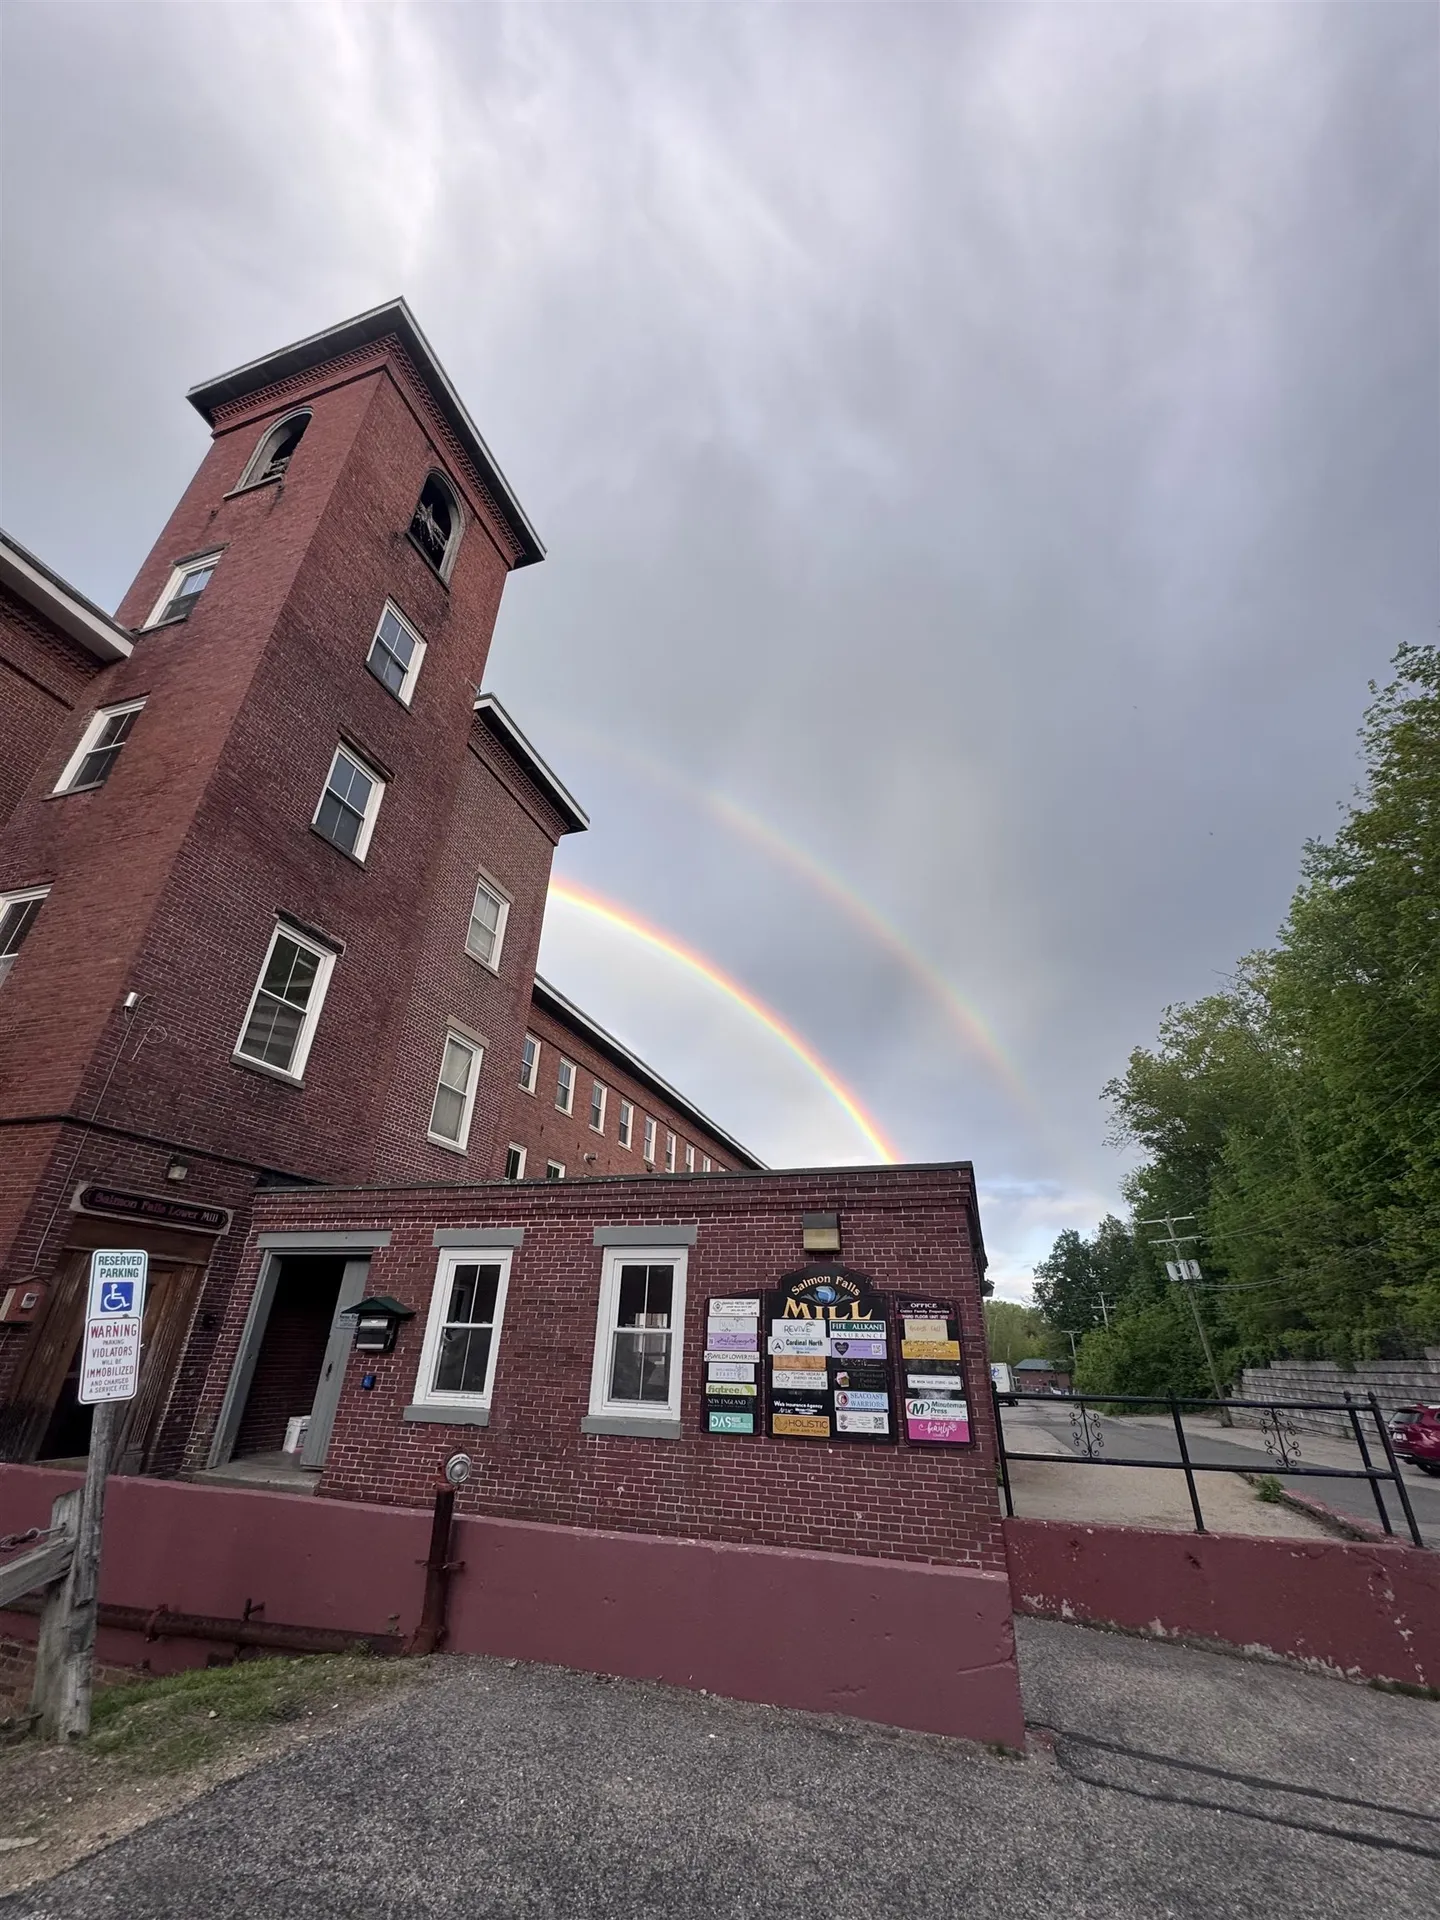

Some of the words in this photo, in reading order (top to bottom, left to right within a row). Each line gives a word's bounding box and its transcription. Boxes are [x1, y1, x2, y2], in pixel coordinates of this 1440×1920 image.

[95, 1192, 138, 1209] Salmon
[140, 1200, 166, 1214] Falls
[167, 1206, 199, 1219] Lower
[200, 1211, 219, 1223] Mill
[98, 1255, 143, 1266] RESERVED
[100, 1267, 139, 1278] PARKING
[791, 1275, 831, 1296] Salmon
[835, 1276, 861, 1296] Falls
[781, 1296, 873, 1320] MILL
[91, 1324, 137, 1339] WARNING
[783, 1324, 812, 1334] REVIVE
[103, 1338, 125, 1346] PARKING
[786, 1338, 808, 1346] Cardinal
[808, 1339, 823, 1347] North
[92, 1345, 133, 1359] VIOLATORS
[87, 1364, 134, 1379] IMMOBILIZED
[91, 1379, 103, 1387] AND
[103, 1377, 129, 1386] CHARGED
[95, 1385, 118, 1394] SERVICE
[707, 1384, 740, 1395] figtree
[850, 1392, 884, 1400] SEACOAST
[851, 1400, 885, 1408] WARRIORS
[931, 1401, 967, 1409] Minuteman
[711, 1415, 733, 1428] DAS
[788, 1419, 829, 1430] HOLISTIC
